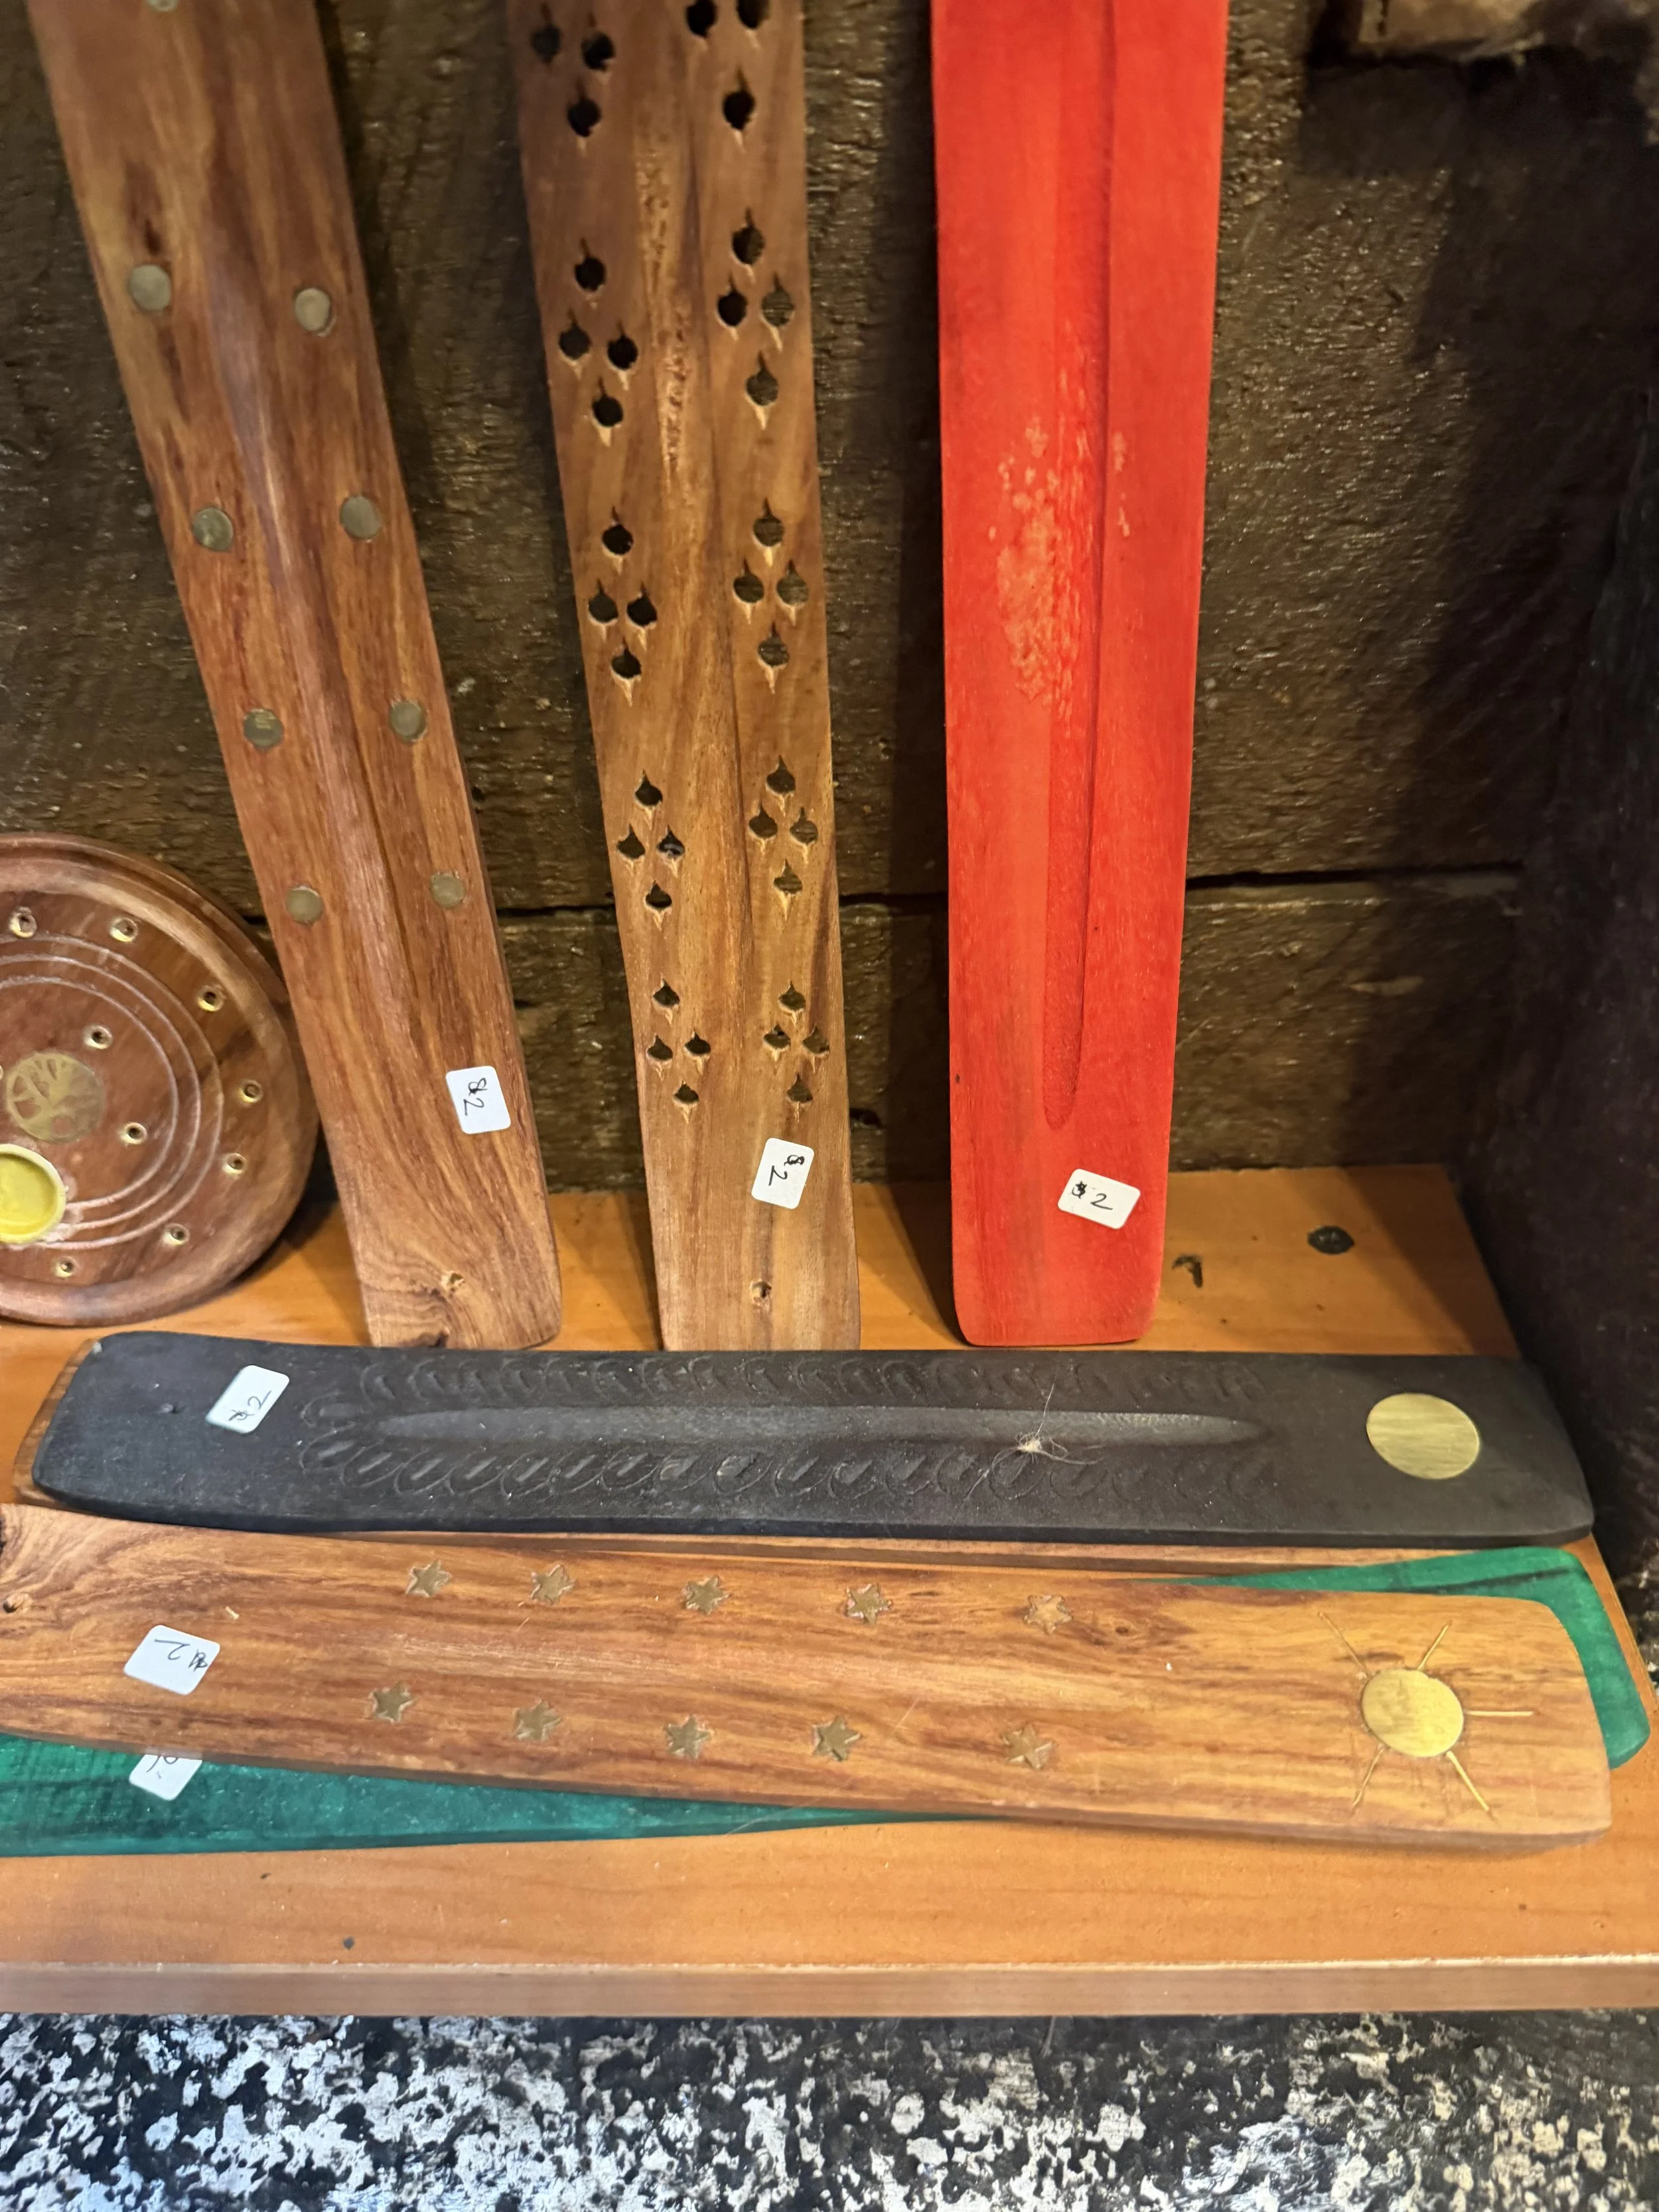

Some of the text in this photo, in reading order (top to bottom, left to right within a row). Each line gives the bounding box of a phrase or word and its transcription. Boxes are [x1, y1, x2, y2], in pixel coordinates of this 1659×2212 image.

[463, 1077, 488, 1116] $2
[768, 1153, 805, 1186] $2
[1071, 1180, 1114, 1211] $2
[228, 1390, 272, 1422] $2
[154, 1638, 208, 1670] $2
